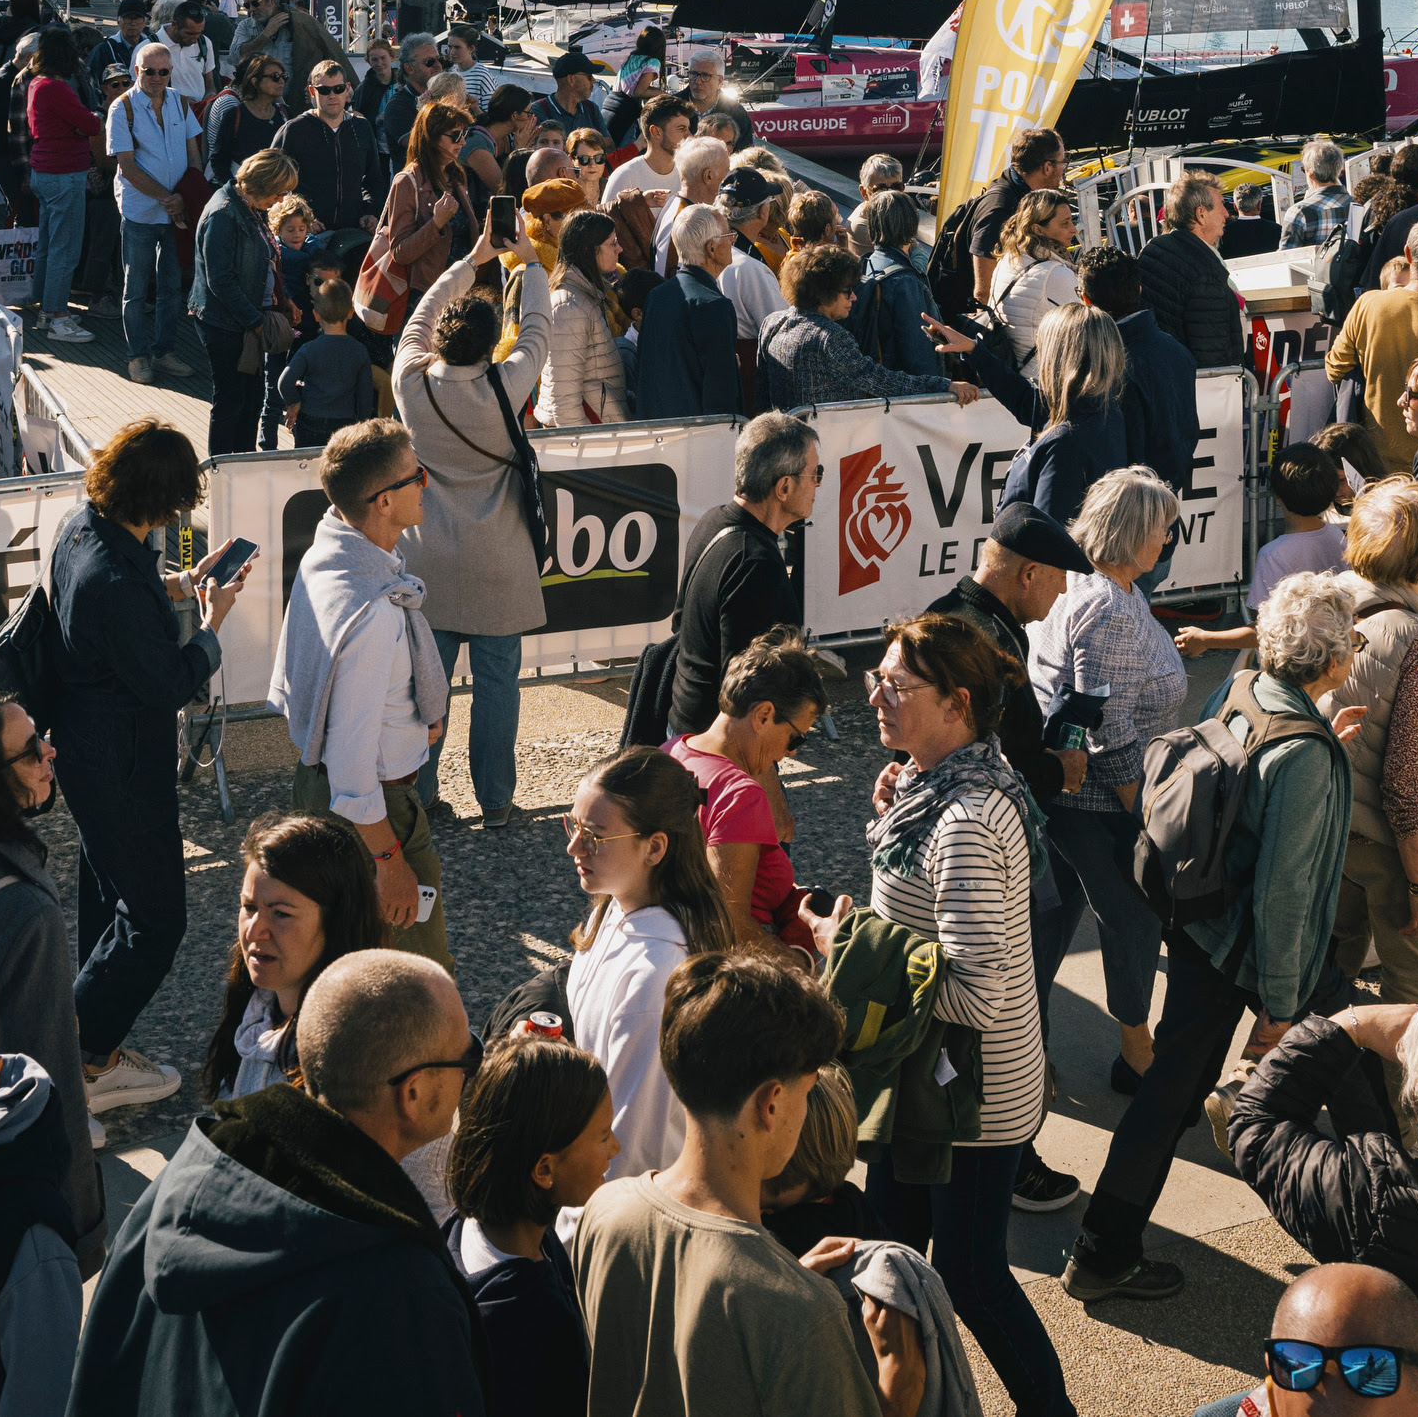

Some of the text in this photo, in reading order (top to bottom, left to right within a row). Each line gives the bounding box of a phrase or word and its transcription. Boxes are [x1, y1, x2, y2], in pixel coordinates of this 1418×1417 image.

[1275, 0, 1310, 10] HUBLOT
[1228, 99, 1254, 108] HUBLOT
[872, 114, 902, 125] arilim
[1125, 108, 1190, 122] HUBLOT
[754, 117, 848, 133] YOUR GUIDE
[918, 538, 958, 578] LE
